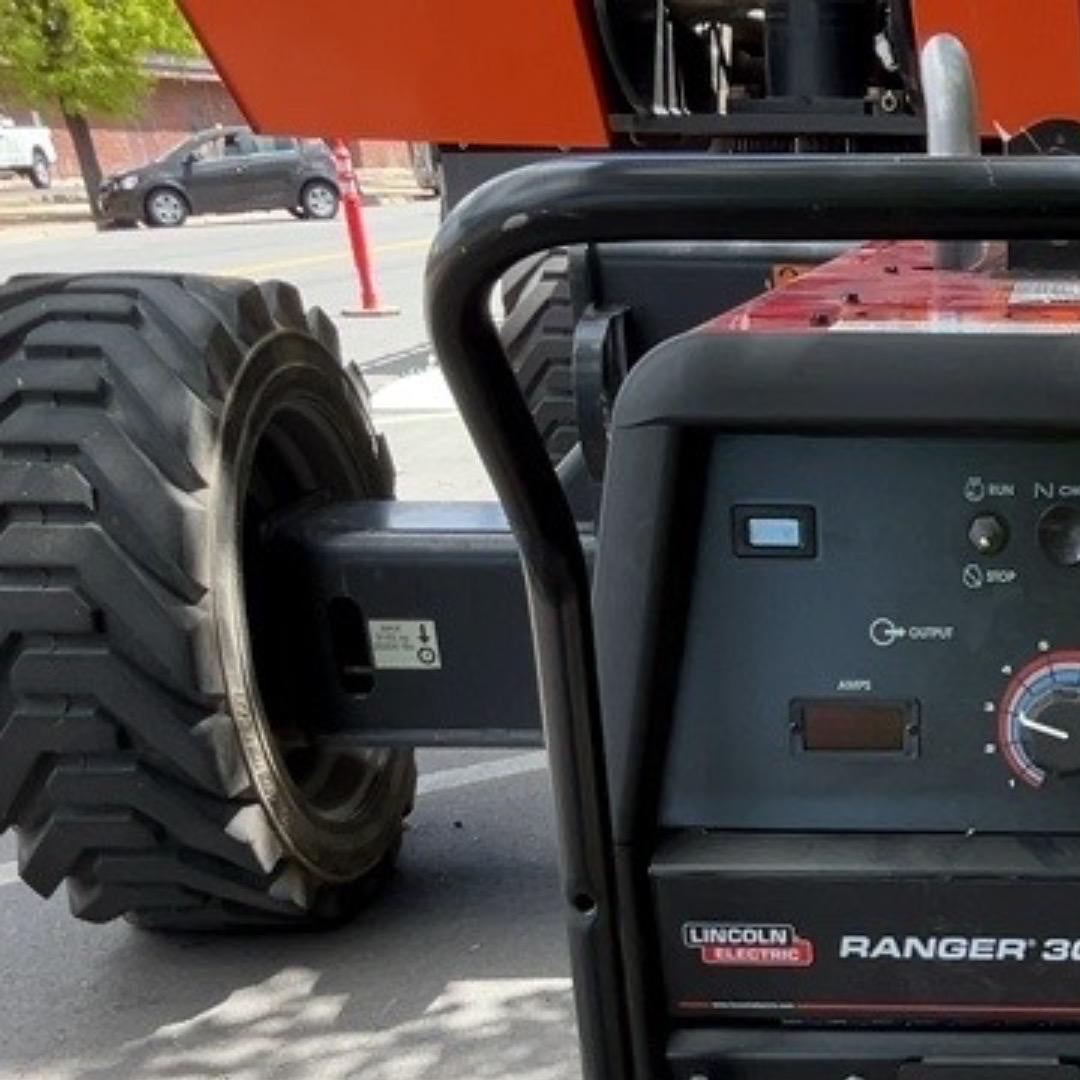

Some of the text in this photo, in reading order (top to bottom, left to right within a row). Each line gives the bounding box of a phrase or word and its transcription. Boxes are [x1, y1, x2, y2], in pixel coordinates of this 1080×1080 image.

[986, 569, 1017, 583] STOP
[908, 626, 954, 640] OUTPUT
[836, 680, 872, 691] AMPS
[689, 928, 788, 944] LINCOLN
[715, 947, 800, 961] ELECTRIC
